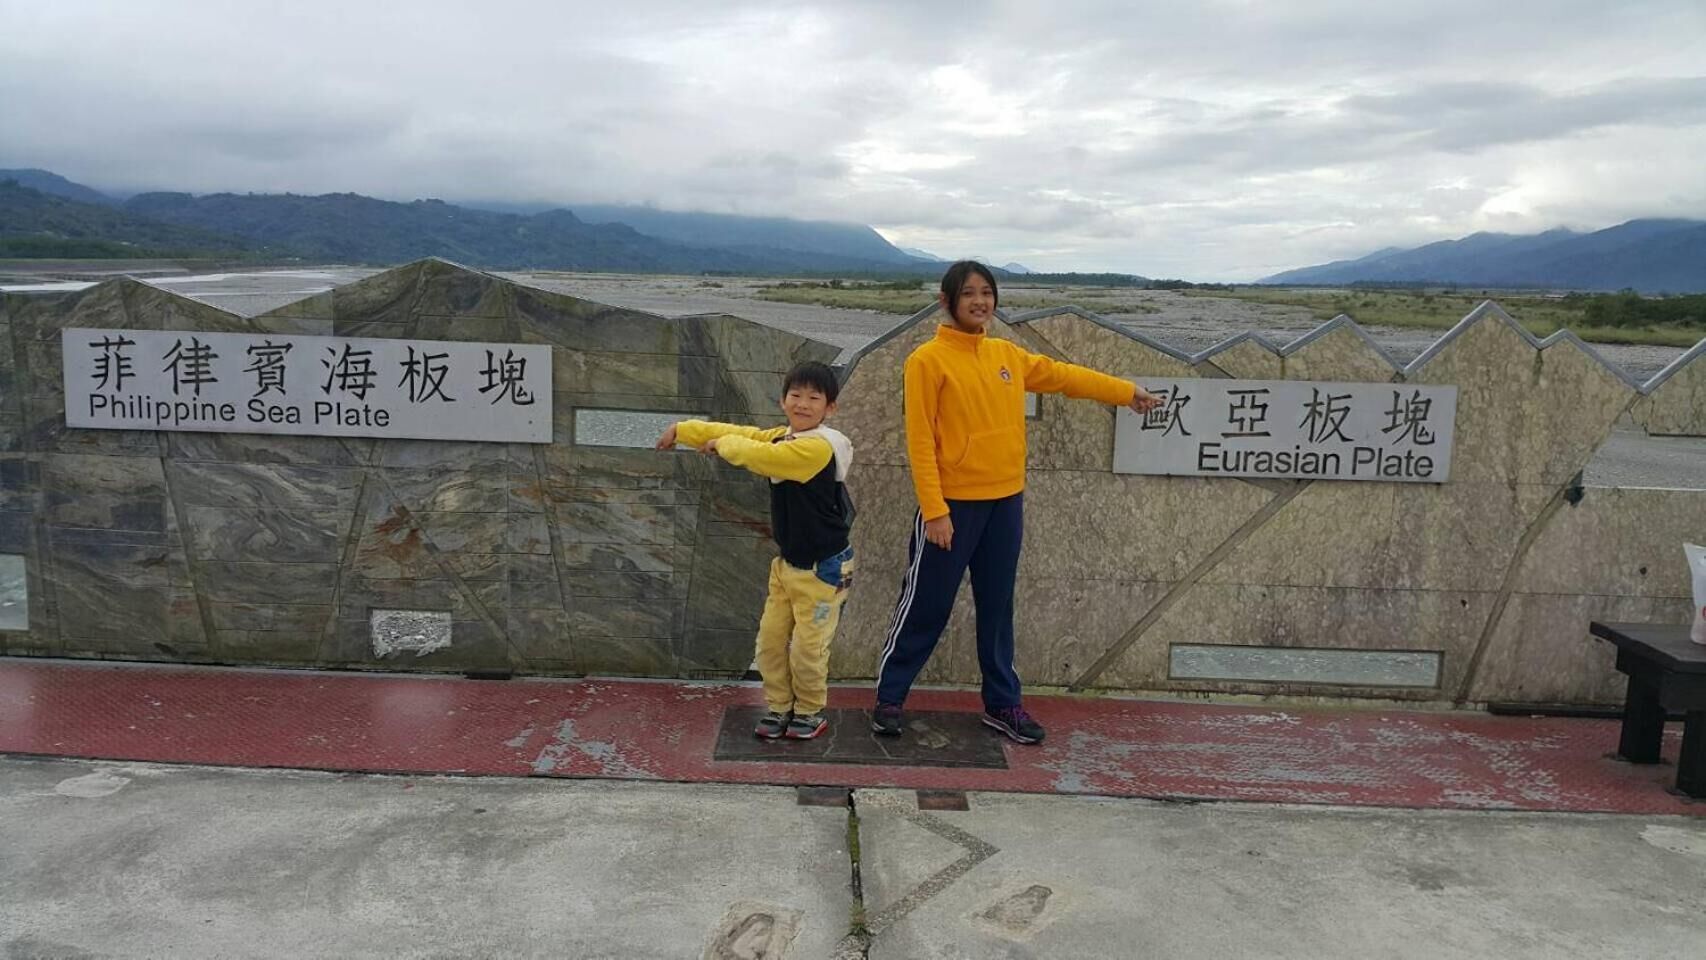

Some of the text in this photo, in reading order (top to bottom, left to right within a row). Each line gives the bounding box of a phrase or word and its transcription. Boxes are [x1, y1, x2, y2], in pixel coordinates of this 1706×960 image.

[89, 335, 535, 407] 菲律賓海板塊
[89, 394, 390, 428] Philippine Sea Plate
[1140, 384, 1436, 446] 歐亞板塊
[1197, 442, 1434, 478] Eurasian Plate
